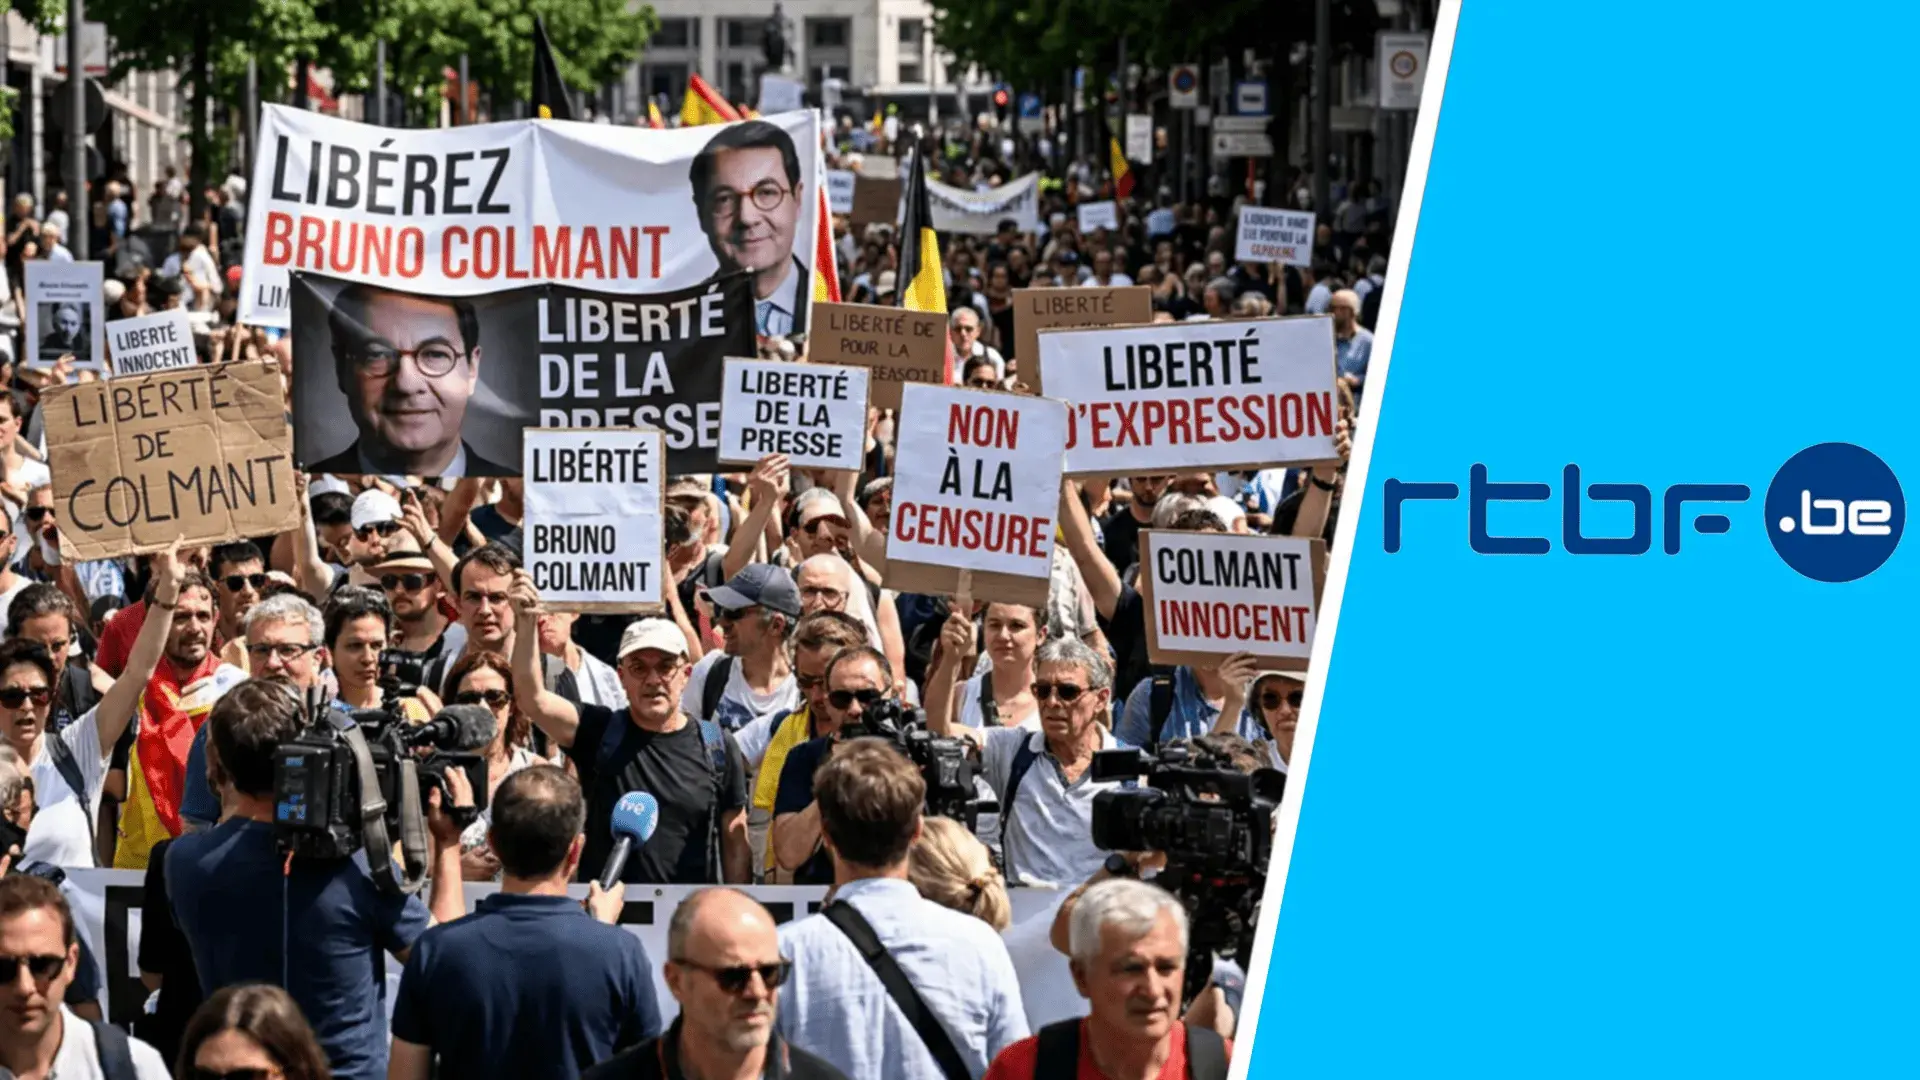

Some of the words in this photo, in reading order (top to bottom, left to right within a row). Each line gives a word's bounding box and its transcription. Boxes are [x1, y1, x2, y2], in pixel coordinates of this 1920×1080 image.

[271, 135, 511, 215] LIBÉREZ
[262, 211, 424, 280] BRUNO
[440, 224, 670, 280] COLMANT
[538, 285, 726, 343] LIBERTÉ
[1032, 288, 1115, 316] LIBERTÉ
[116, 320, 178, 351] LIBERTÉ
[830, 312, 906, 336] LIBERTÉ
[913, 320, 935, 338] DE
[117, 346, 191, 374] INNOCENT
[840, 337, 880, 355] POUR
[888, 343, 910, 358] LA
[1103, 327, 1262, 392] LIBERTÉ
[539, 352, 600, 399] DE
[615, 352, 675, 397] LA
[740, 369, 849, 400] LIBERTÉ
[755, 399, 790, 425] DE
[798, 402, 831, 428] LA
[947, 403, 1020, 450] NON
[132, 430, 175, 462] DE
[532, 441, 649, 484] LIBÉRTÉ
[740, 427, 843, 458] PRESSE
[68, 454, 286, 532] COLMANT
[939, 447, 963, 497] À
[971, 459, 1014, 502] LA
[533, 524, 616, 555] BRUNO
[894, 501, 1051, 559] CENSURE
[533, 561, 651, 592] COLMANT
[1156, 546, 1302, 591] COLMANT
[1160, 599, 1310, 644] INNOCENT
